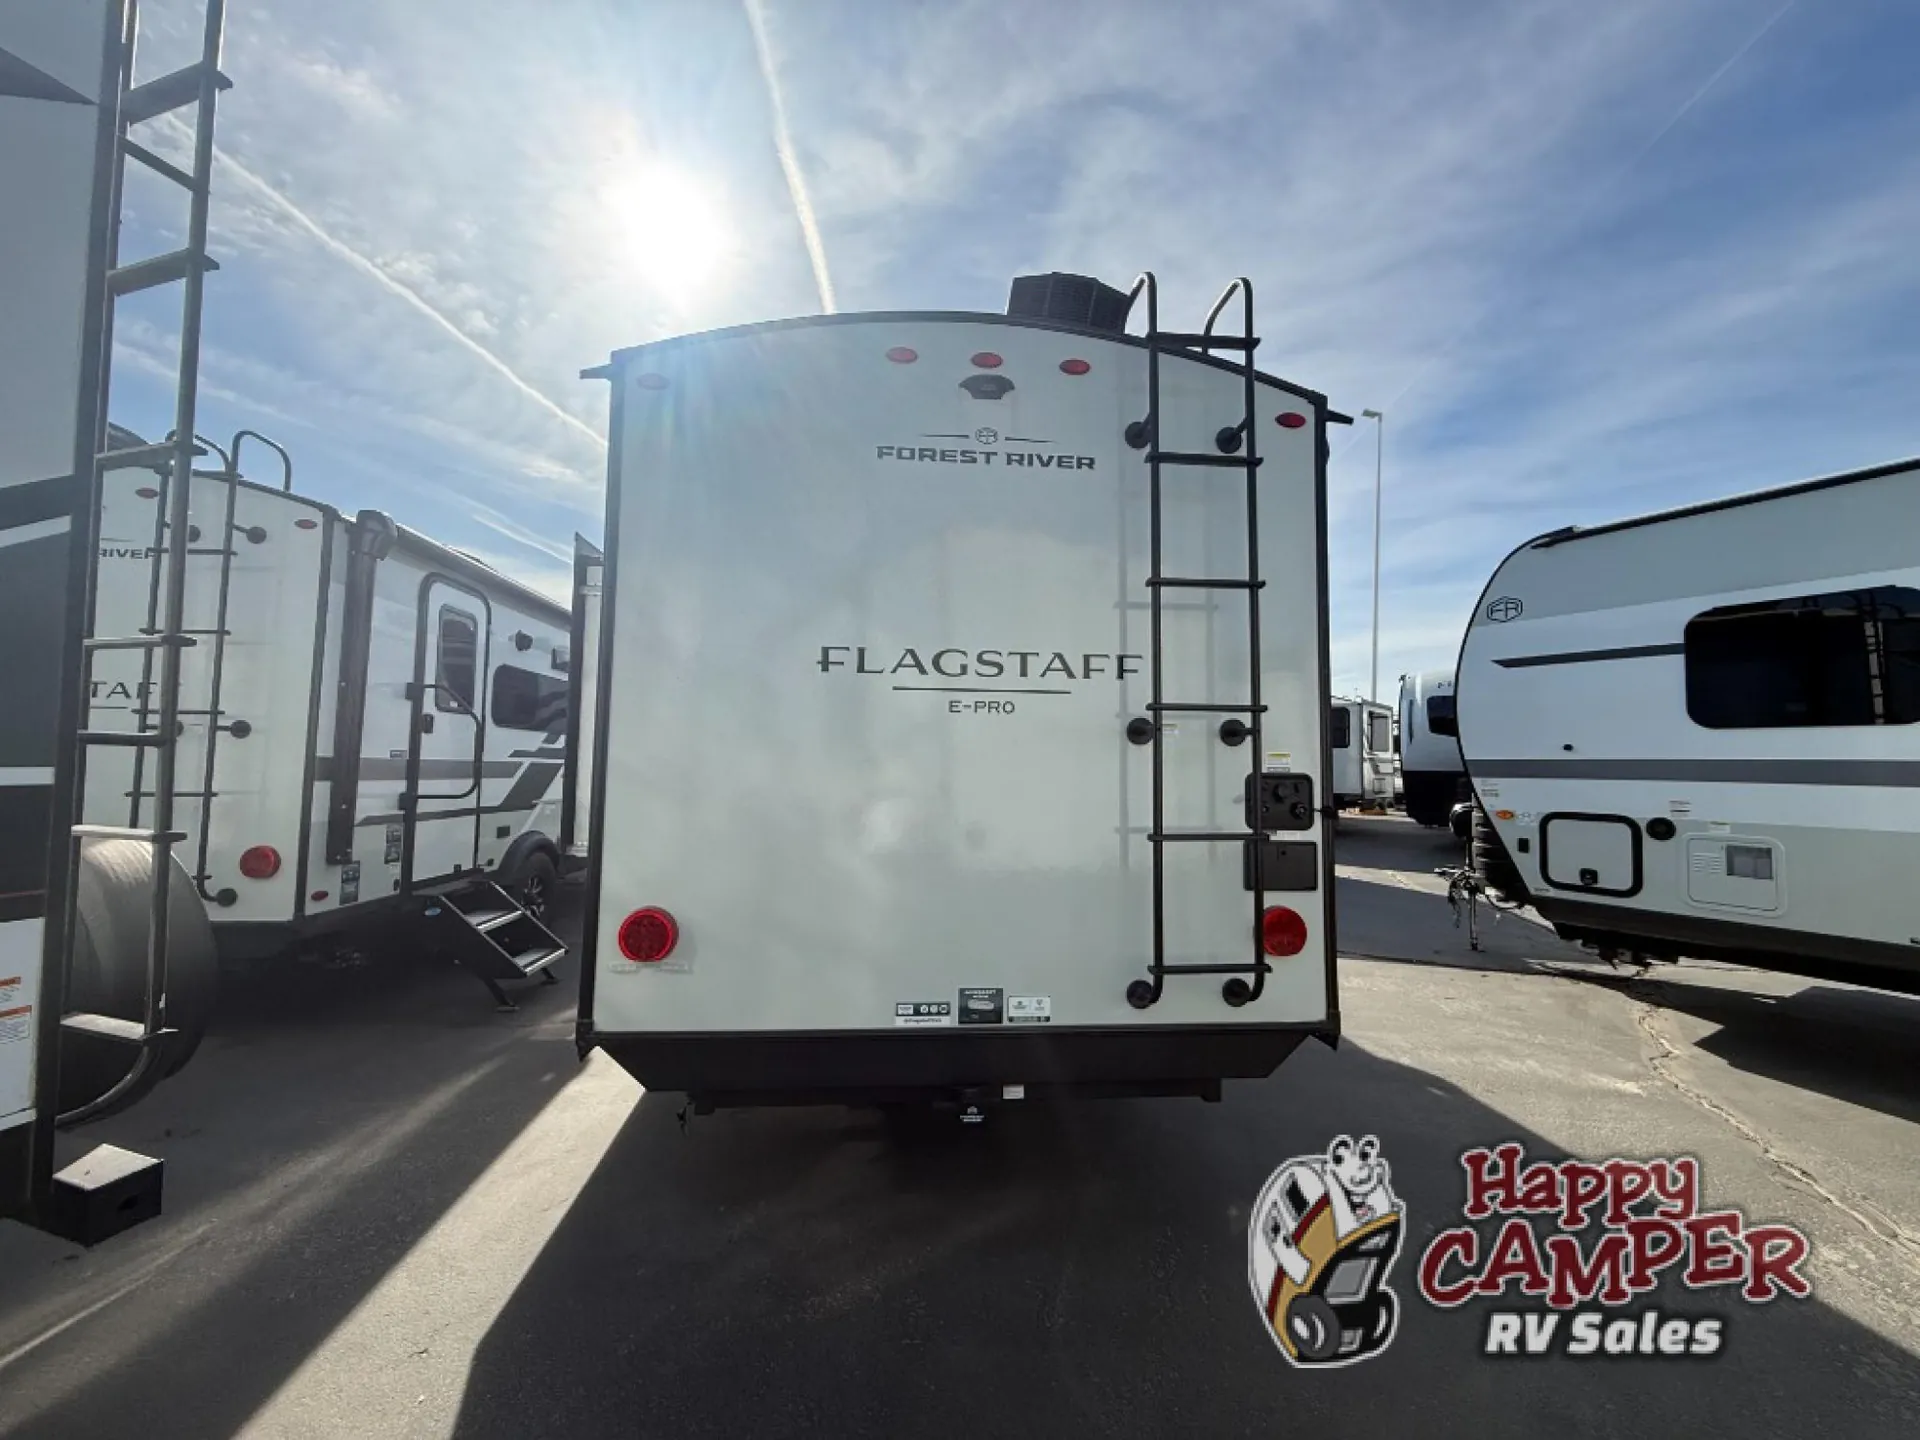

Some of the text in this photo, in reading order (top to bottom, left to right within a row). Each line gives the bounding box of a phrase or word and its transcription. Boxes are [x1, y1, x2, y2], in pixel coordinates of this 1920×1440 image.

[876, 446, 1096, 469] FOREST RIVER
[816, 646, 1143, 680] FLAGSTAFF
[948, 700, 1015, 715] E-PRO
